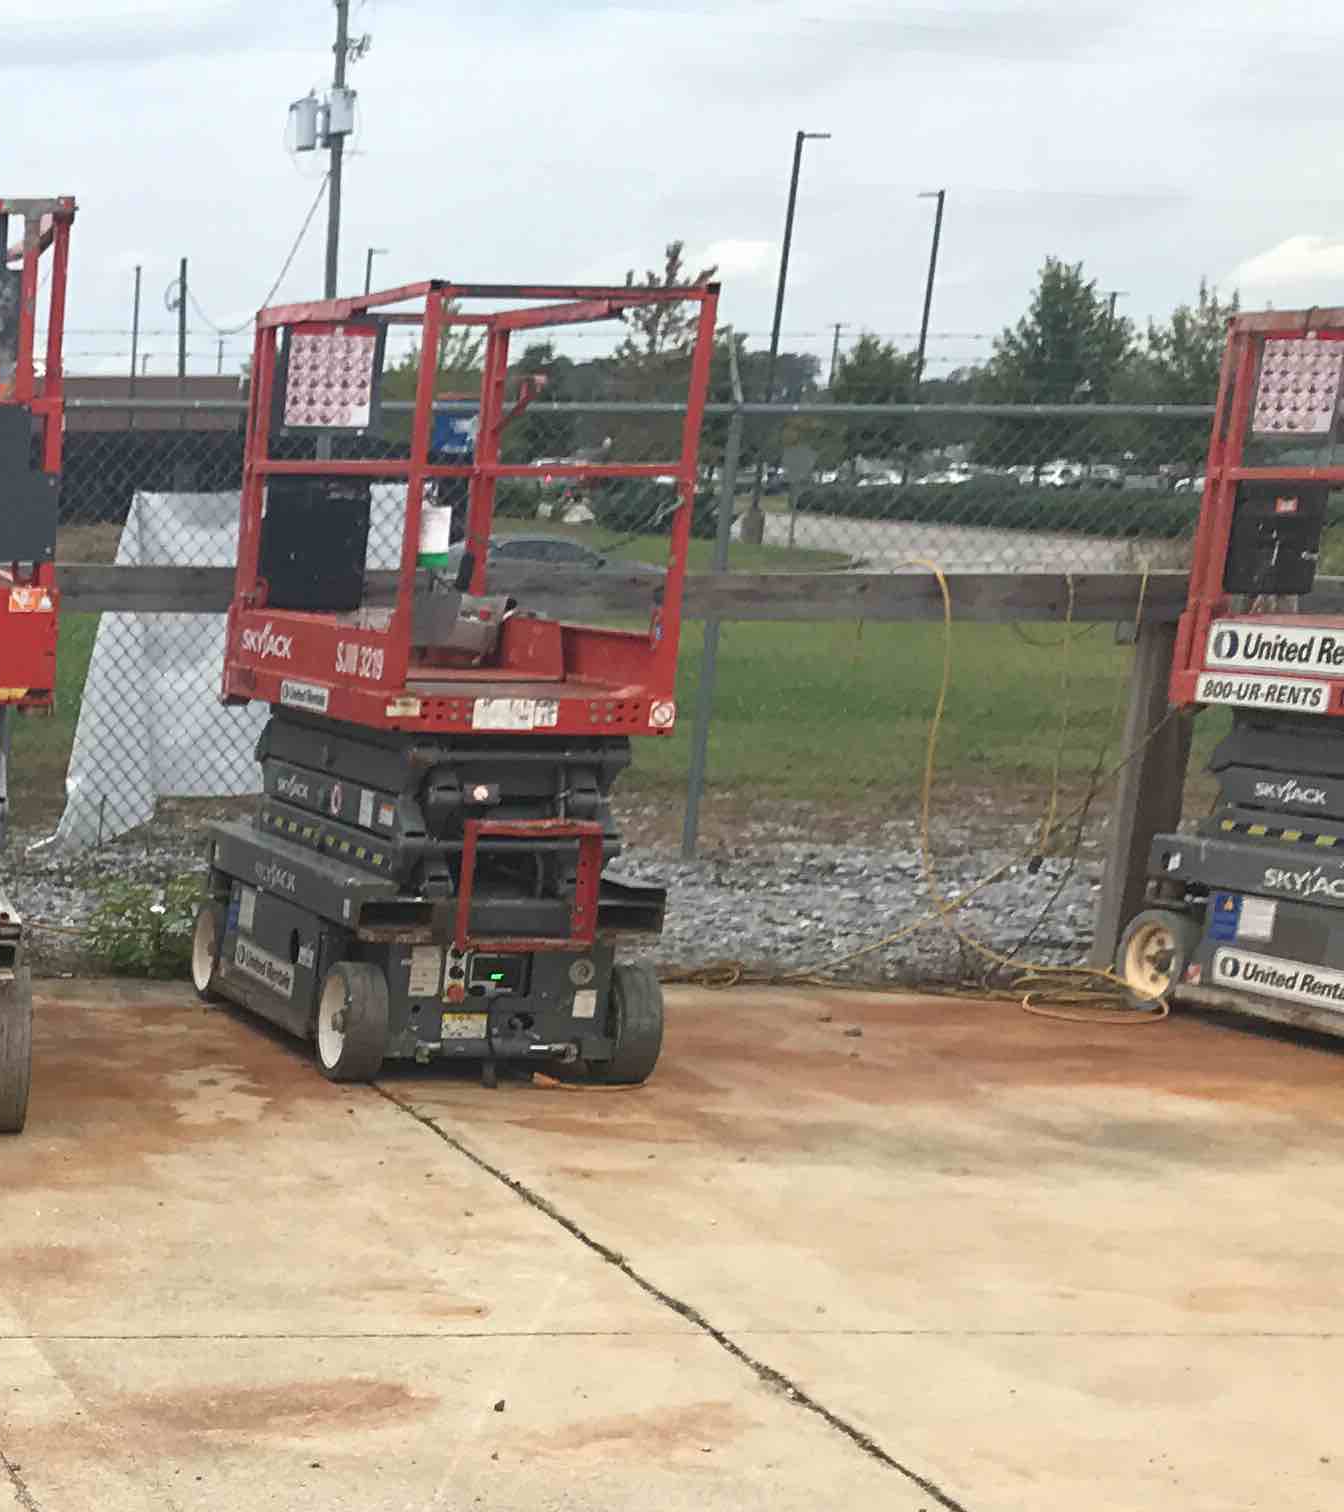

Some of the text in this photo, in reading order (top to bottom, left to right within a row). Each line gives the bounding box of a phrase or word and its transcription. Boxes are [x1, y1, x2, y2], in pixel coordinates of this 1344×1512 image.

[1243, 632, 1314, 663] United
[1202, 680, 1322, 706] 800-UR-RENTS
[1254, 779, 1327, 805] SKYJACK
[1242, 962, 1298, 990] United
